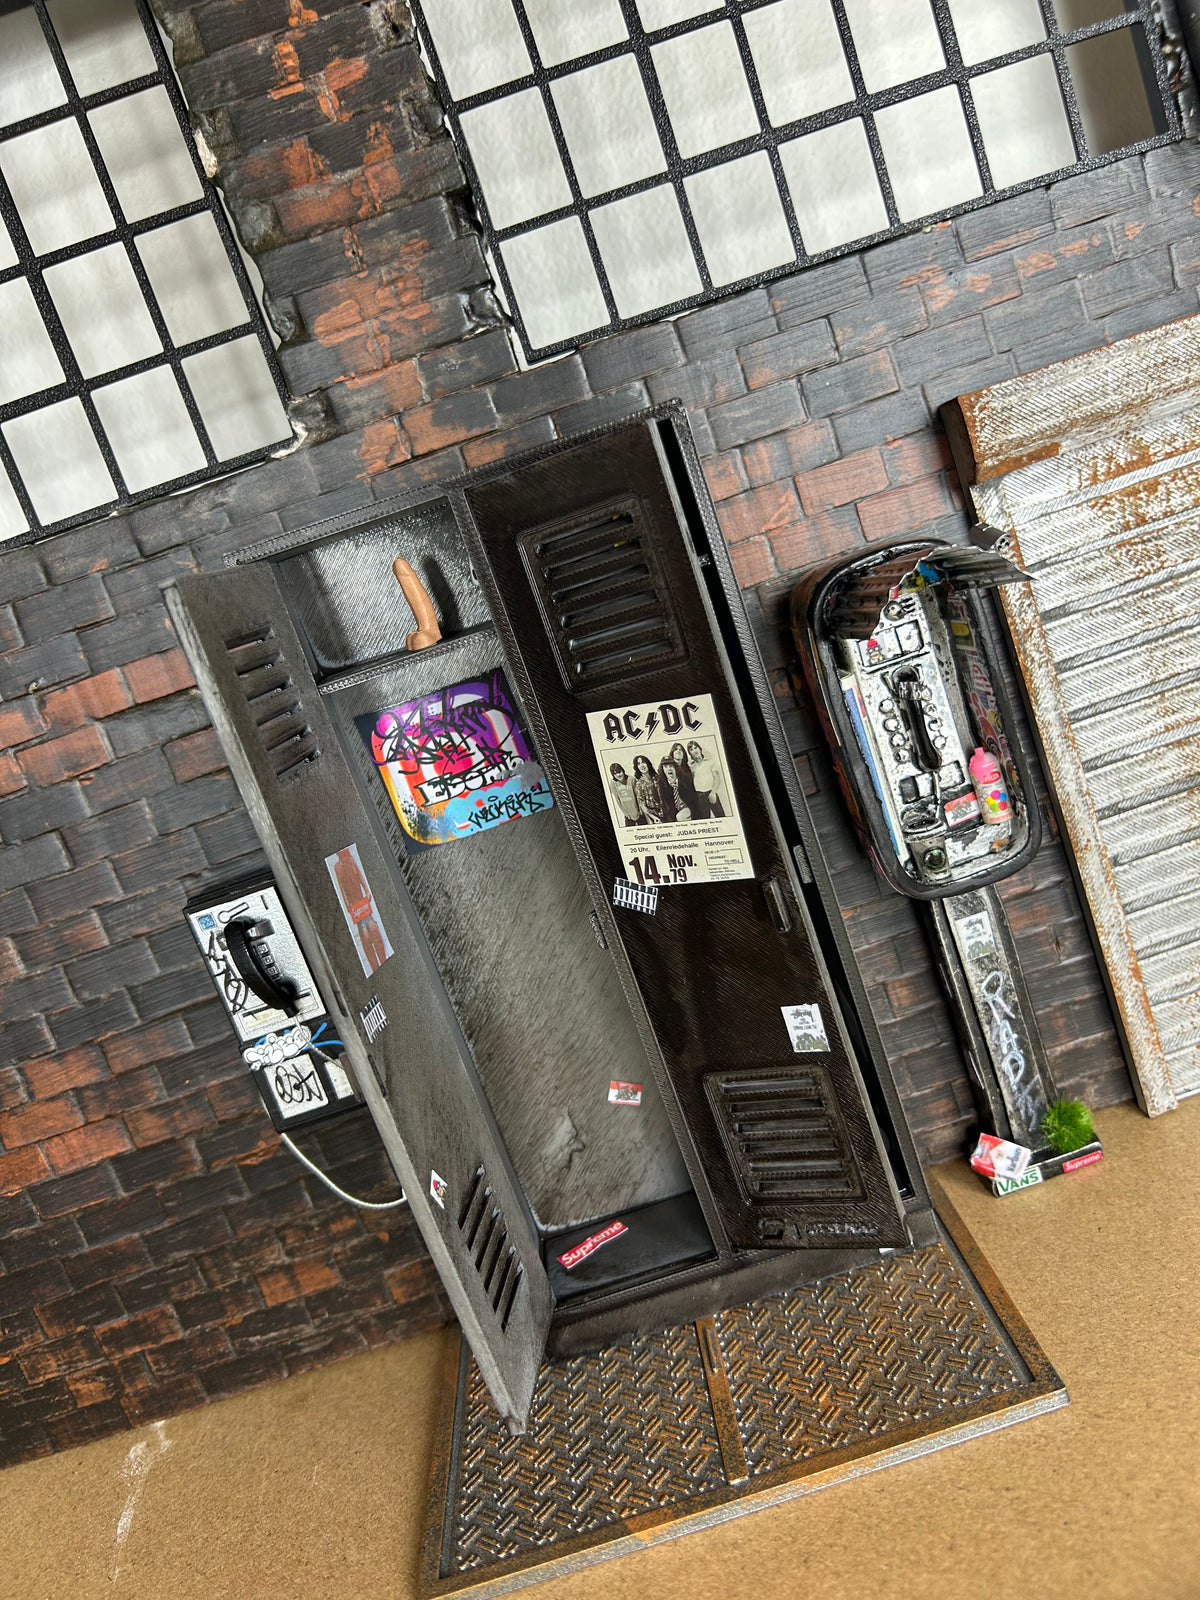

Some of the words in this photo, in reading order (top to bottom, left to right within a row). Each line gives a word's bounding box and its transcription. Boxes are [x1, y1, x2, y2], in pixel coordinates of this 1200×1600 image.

[634, 833, 654, 841] Special
[629, 855, 671, 885] 14.
[667, 854, 697, 868] Nov.
[670, 868, 687, 882] 79
[1065, 1152, 1100, 1171] Supreme
[998, 1171, 1039, 1193] VANS
[561, 1221, 623, 1265] Supreme
